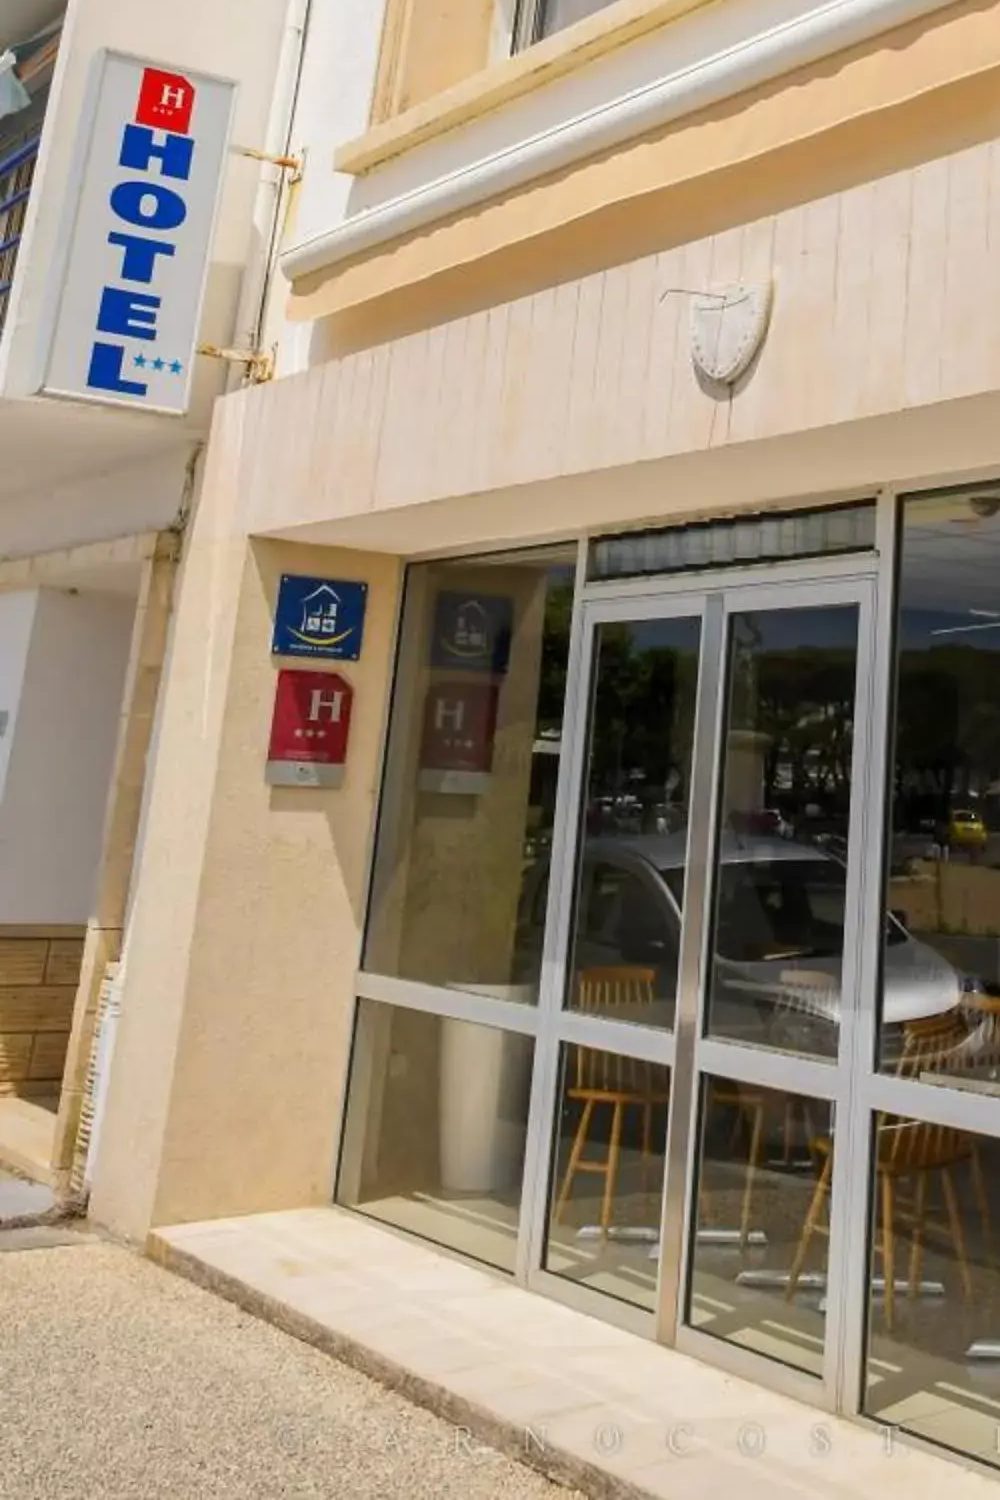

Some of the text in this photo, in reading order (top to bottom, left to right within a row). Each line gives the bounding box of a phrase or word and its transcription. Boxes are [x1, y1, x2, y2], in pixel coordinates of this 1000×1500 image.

[160, 83, 185, 109] H
[86, 123, 195, 396] HOTEL
[307, 689, 343, 722] H
